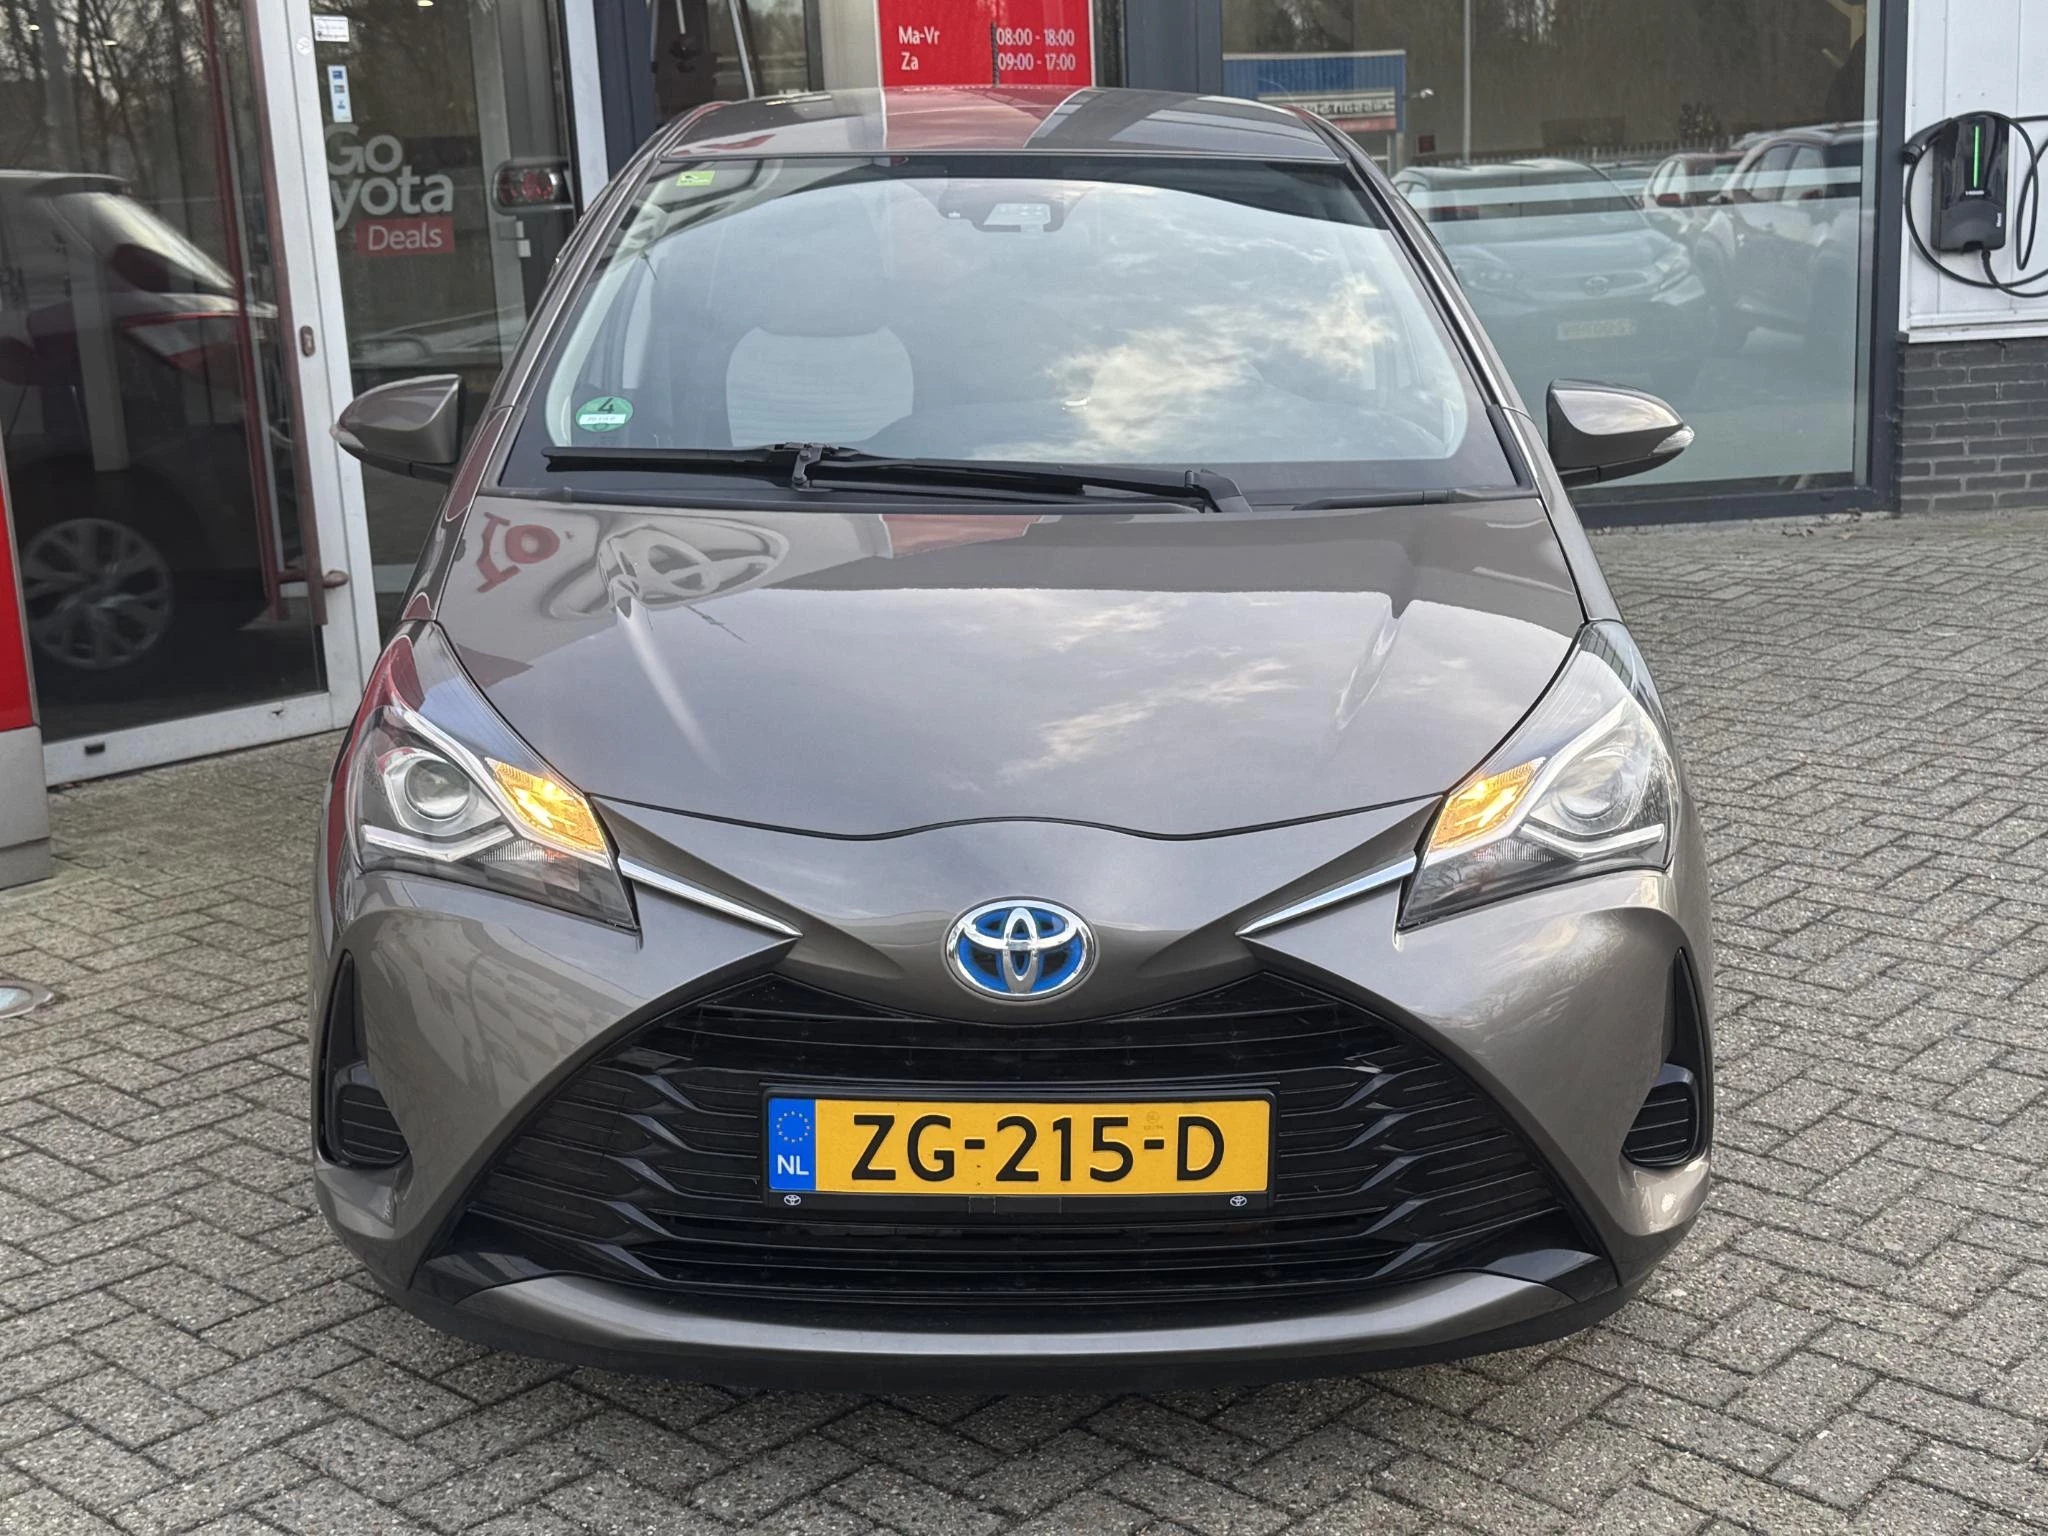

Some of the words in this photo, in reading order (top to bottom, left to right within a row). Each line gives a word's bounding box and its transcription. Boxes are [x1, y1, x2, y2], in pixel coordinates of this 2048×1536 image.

[899, 25, 940, 45] Ma-Vr
[996, 28, 1033, 46] 08:00
[1044, 29, 1075, 47] 18:00
[901, 52, 919, 70] Za
[998, 53, 1034, 71] 09:00
[1045, 53, 1076, 71] 17:00
[324, 122, 403, 175] Go
[368, 221, 443, 251] Deals
[598, 397, 615, 414] 4
[851, 1113, 1225, 1183] ZG-215-D
[777, 1154, 809, 1175] NL
